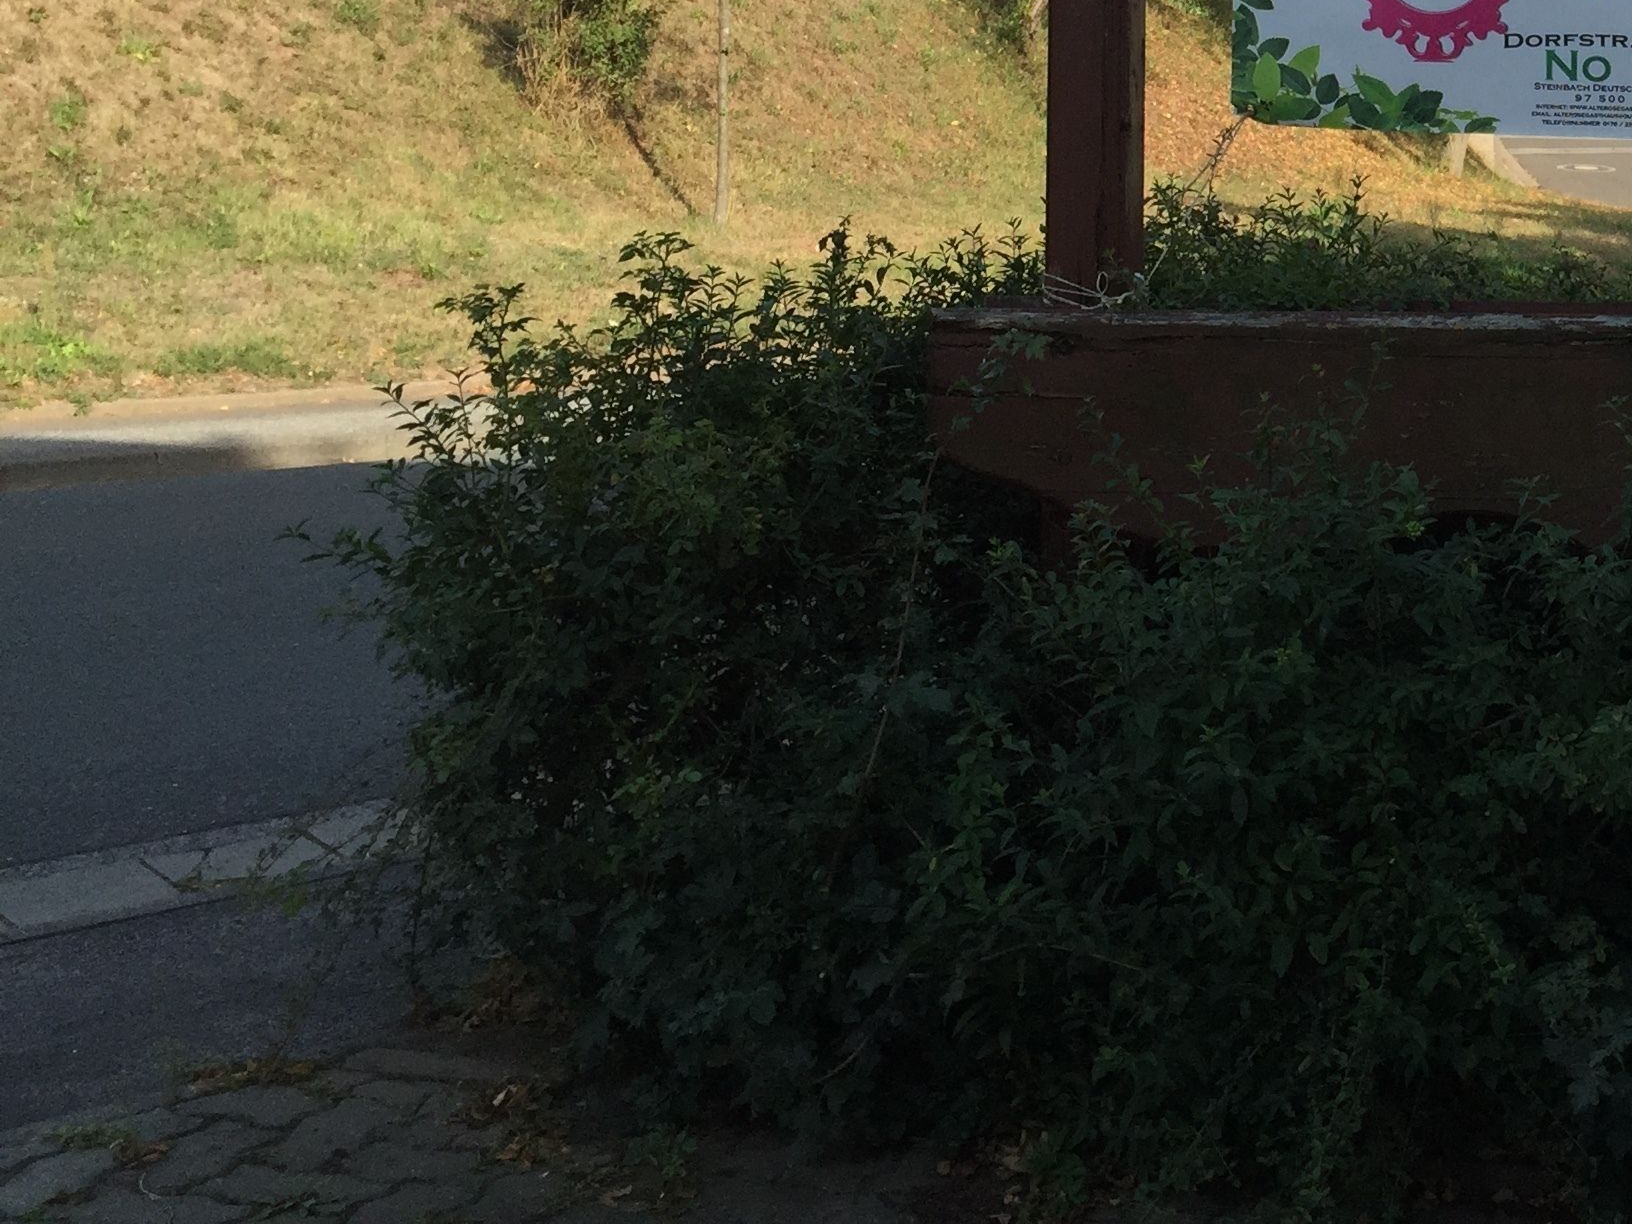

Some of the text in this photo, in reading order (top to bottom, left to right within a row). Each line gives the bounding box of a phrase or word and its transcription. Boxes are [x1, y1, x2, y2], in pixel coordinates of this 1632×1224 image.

[1533, 82, 1591, 92] STEINBACH
[1574, 94, 1626, 104] 97 500
